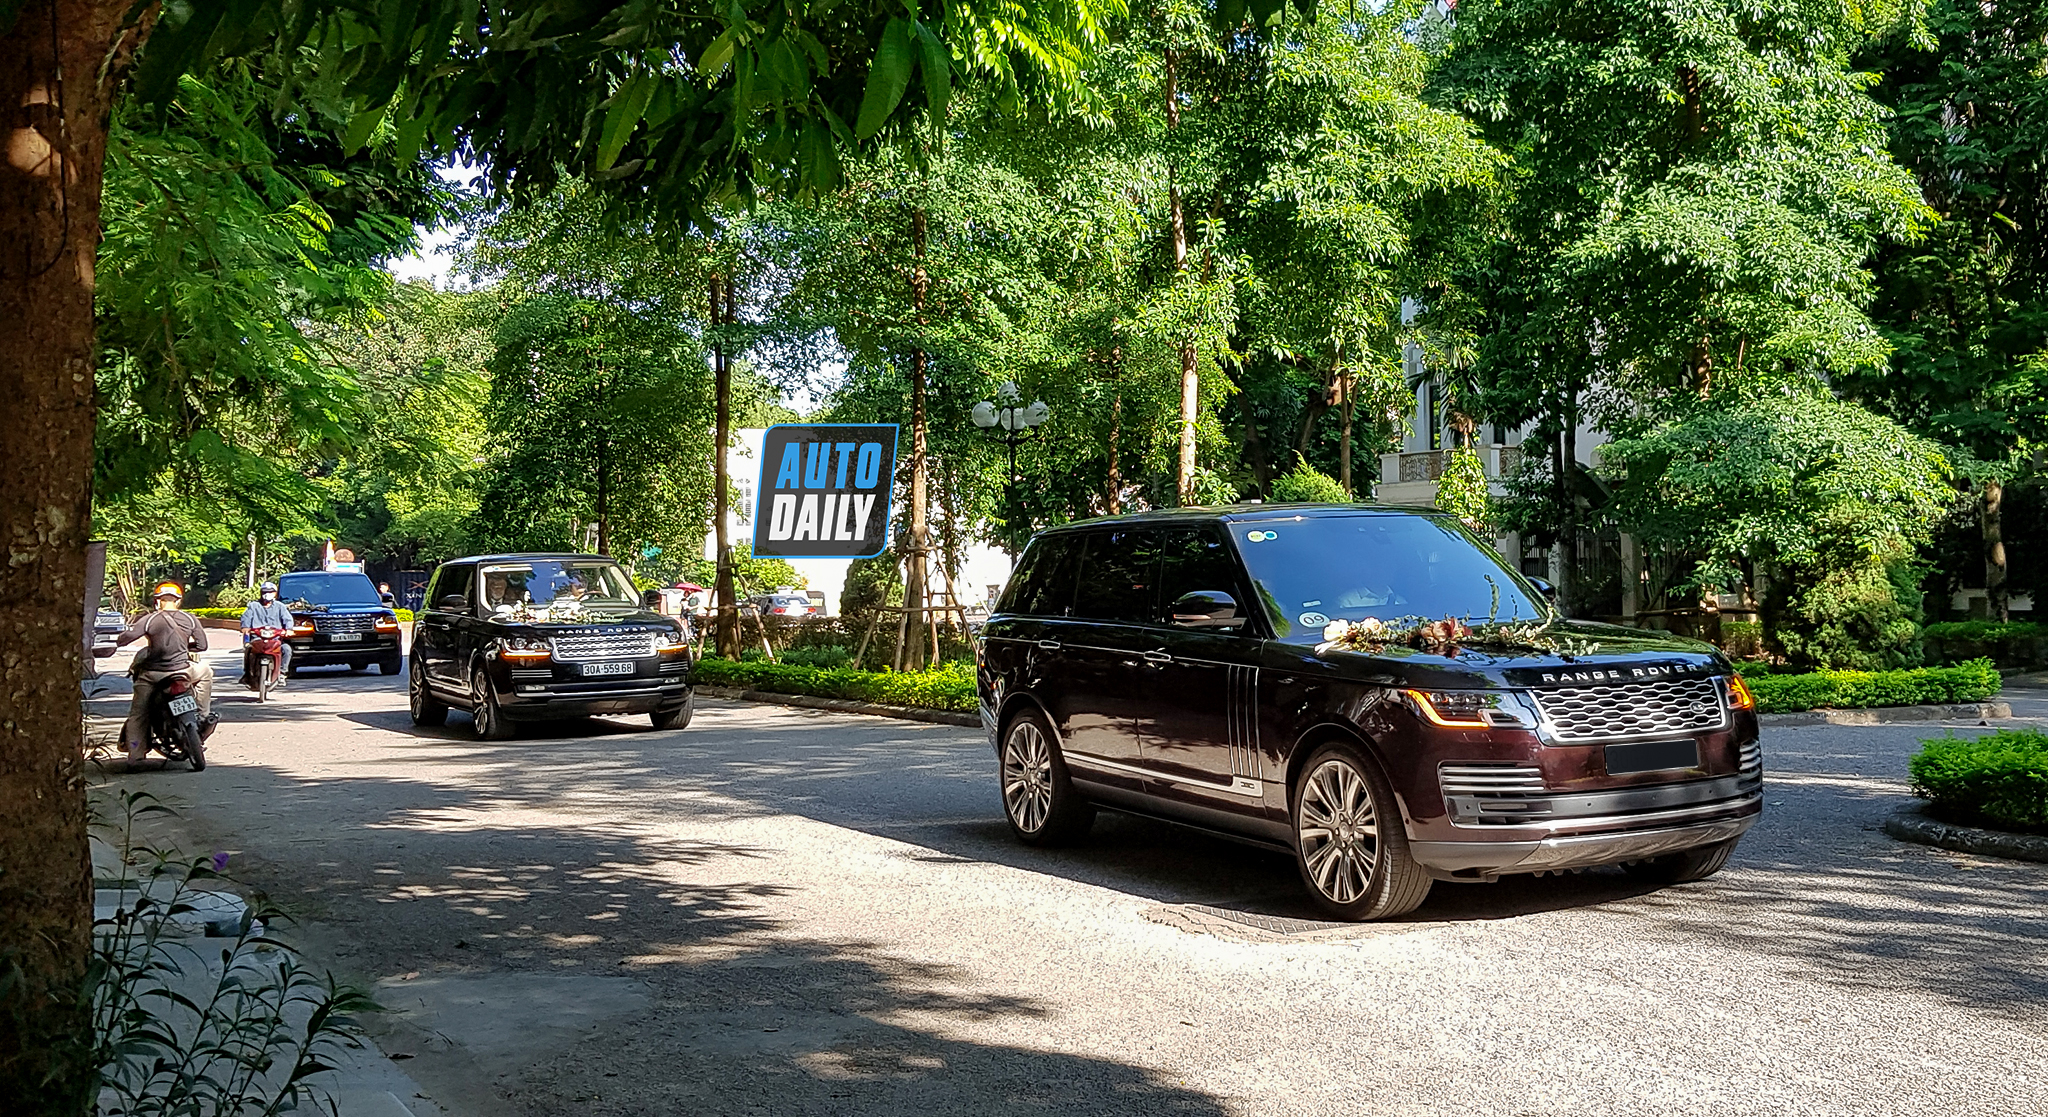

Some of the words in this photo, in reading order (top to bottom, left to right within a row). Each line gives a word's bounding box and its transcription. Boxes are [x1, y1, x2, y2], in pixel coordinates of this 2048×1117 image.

[584, 663, 632, 675] 30A-559.68
[1542, 670, 1620, 682] RANGE
[1632, 664, 1698, 677] ROVER
